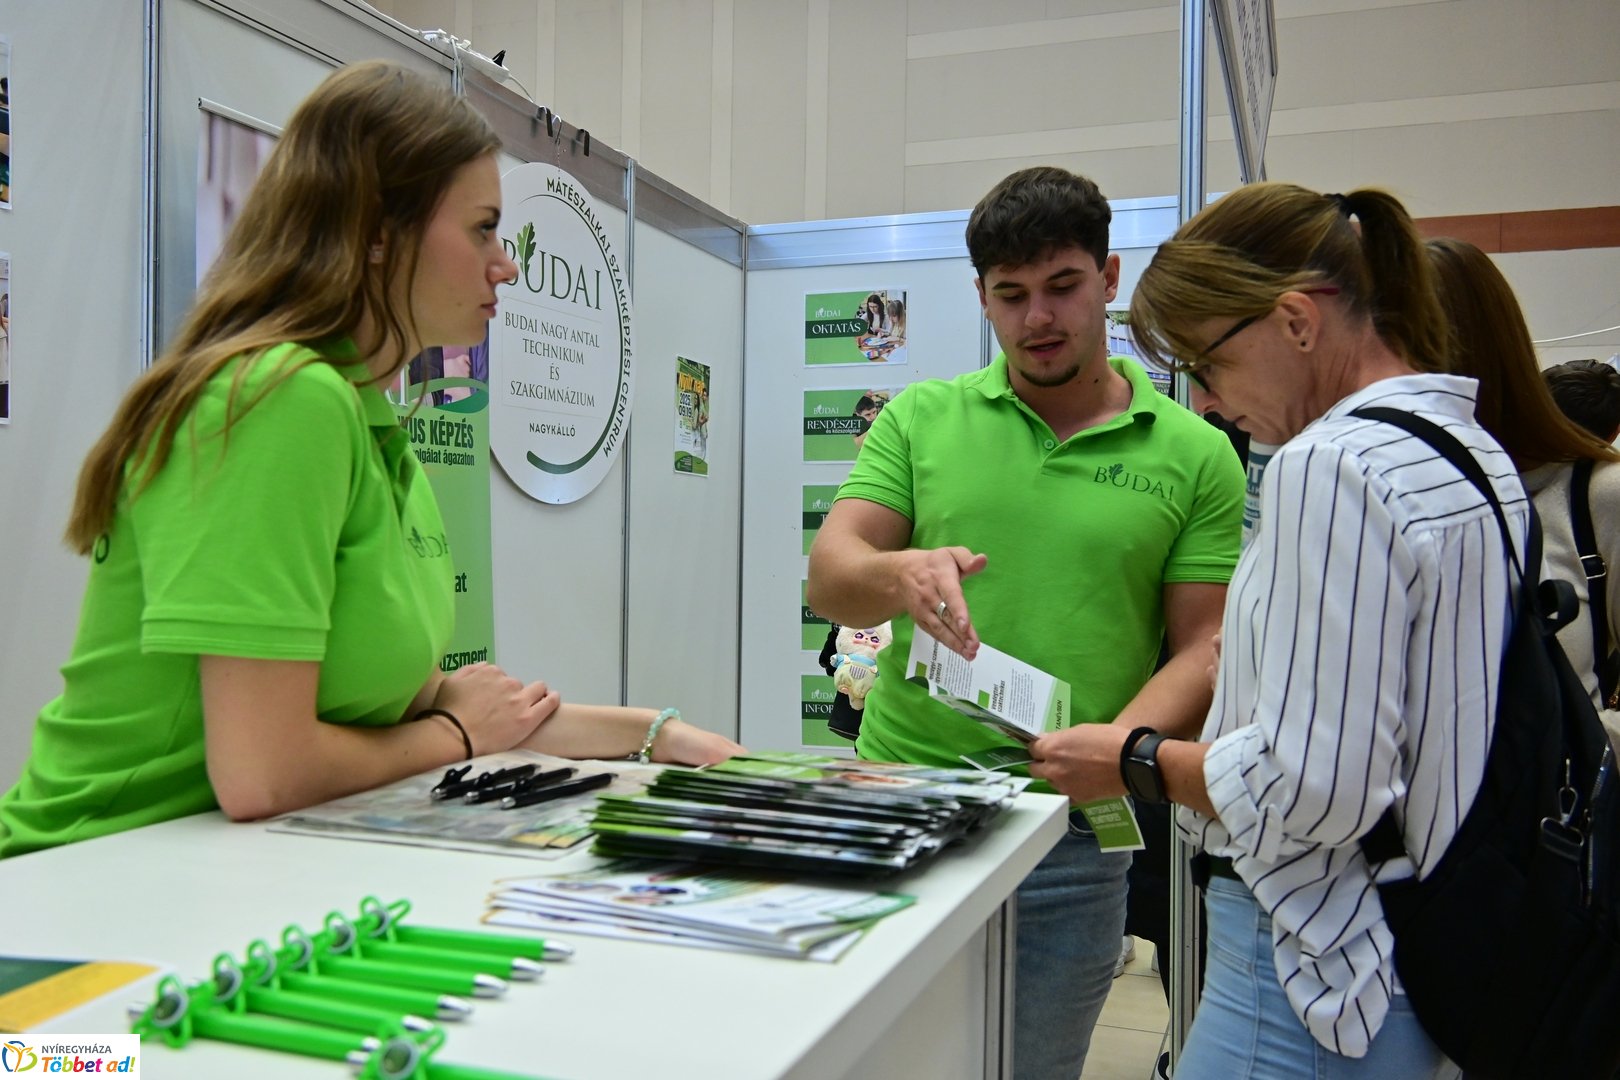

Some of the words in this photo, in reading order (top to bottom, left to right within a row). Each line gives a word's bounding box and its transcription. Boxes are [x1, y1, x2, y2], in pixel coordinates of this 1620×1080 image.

[546, 176, 611, 253] MÁTÉSZALKAI
[609, 254, 633, 377] SZAKKÉPZÉSI
[815, 308, 841, 318] BUDAI
[505, 311, 538, 334] BUDAI
[541, 321, 569, 341] NAGY
[570, 329, 600, 348] ANTAL
[812, 321, 861, 334] OKTATÁS
[522, 338, 584, 365] TECHNIKUM
[549, 363, 560, 381] ÉS
[510, 380, 595, 407] SZAKGIMNÁZIUM
[603, 382, 629, 457] CENTRUM
[807, 419, 862, 429] RENDÉSZET
[814, 406, 839, 415] BUDAI
[430, 415, 474, 449] KÉPZÉS
[529, 422, 576, 437] NAGYKÁLLÓ
[443, 449, 475, 466] ágazaton
[1094, 464, 1175, 501] BUDAI
